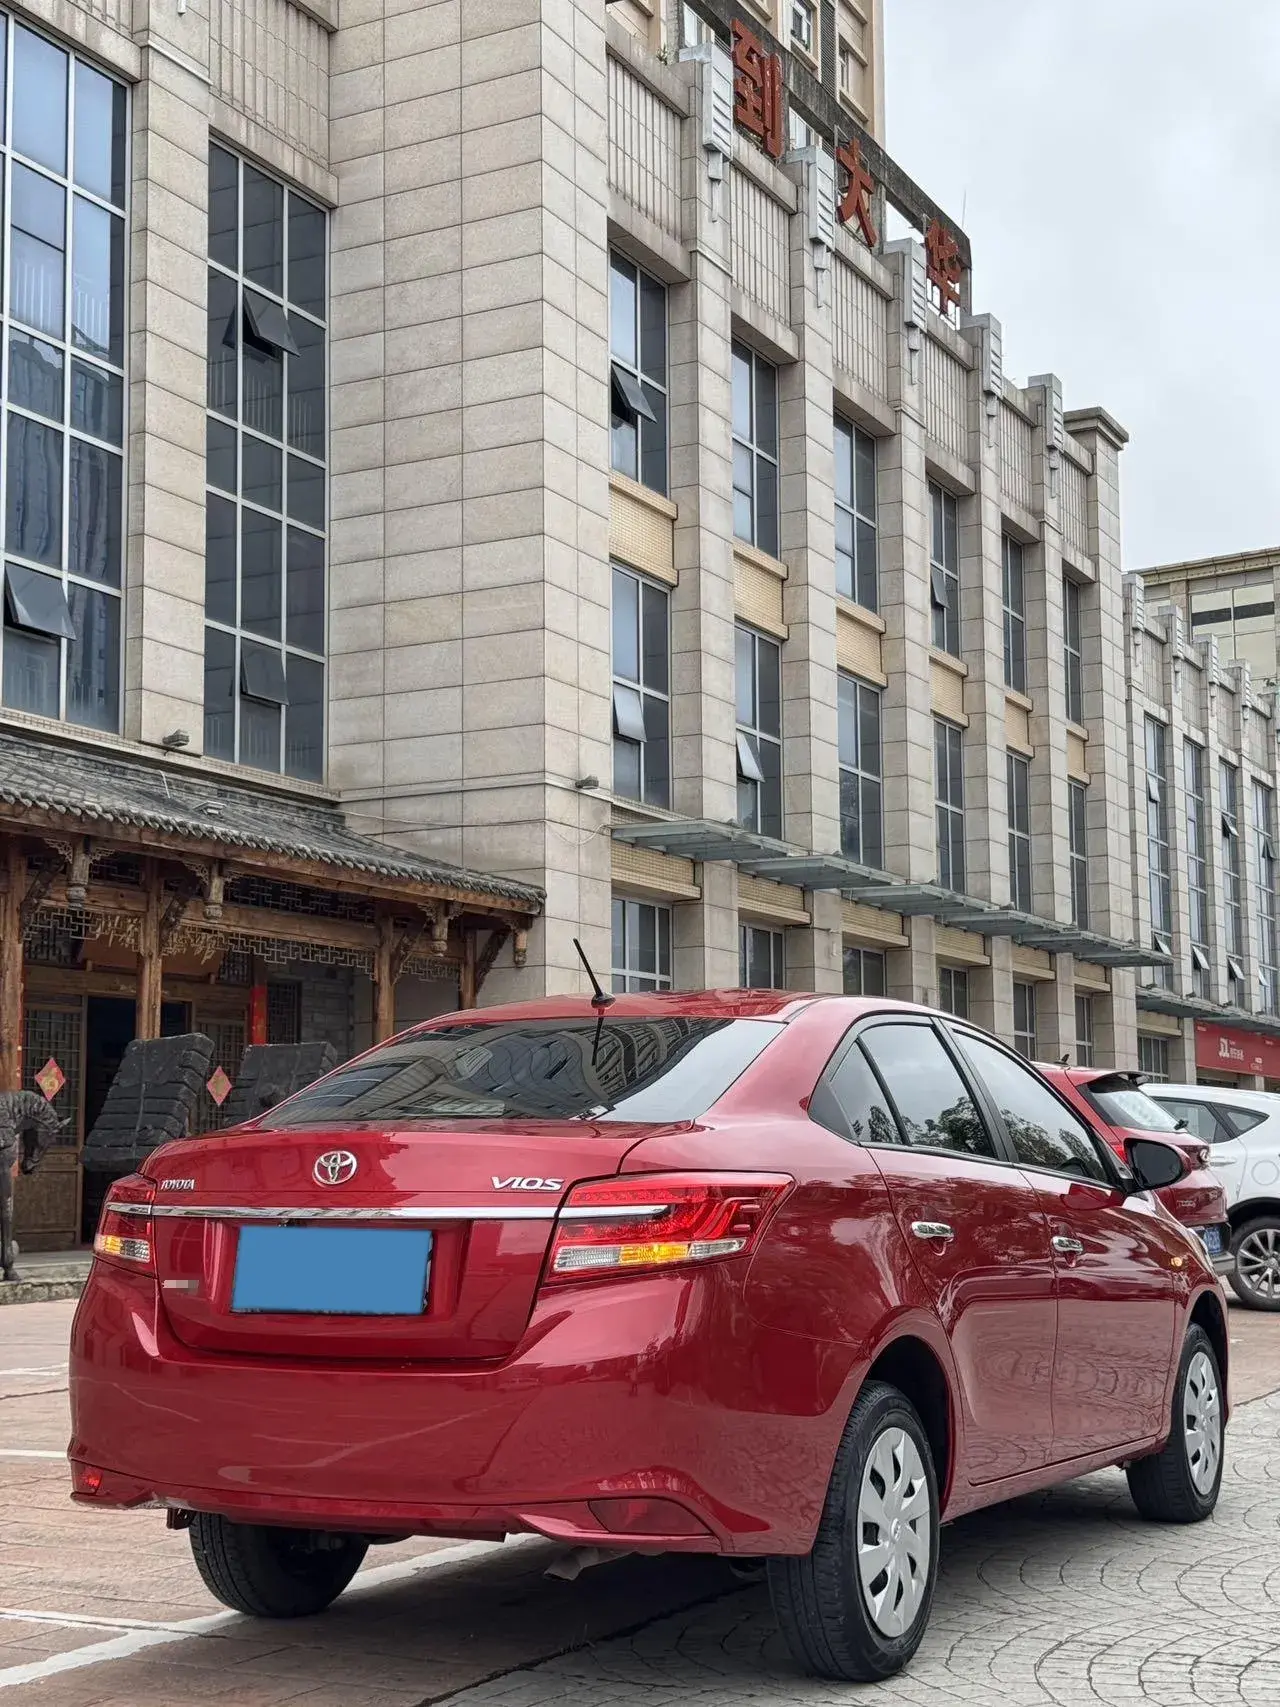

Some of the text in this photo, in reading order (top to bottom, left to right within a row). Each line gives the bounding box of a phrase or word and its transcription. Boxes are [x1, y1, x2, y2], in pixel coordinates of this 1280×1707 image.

[731, 17, 960, 314] 到大华
[160, 1178, 196, 1191] TOYOTA
[491, 1176, 565, 1191] VIOS
